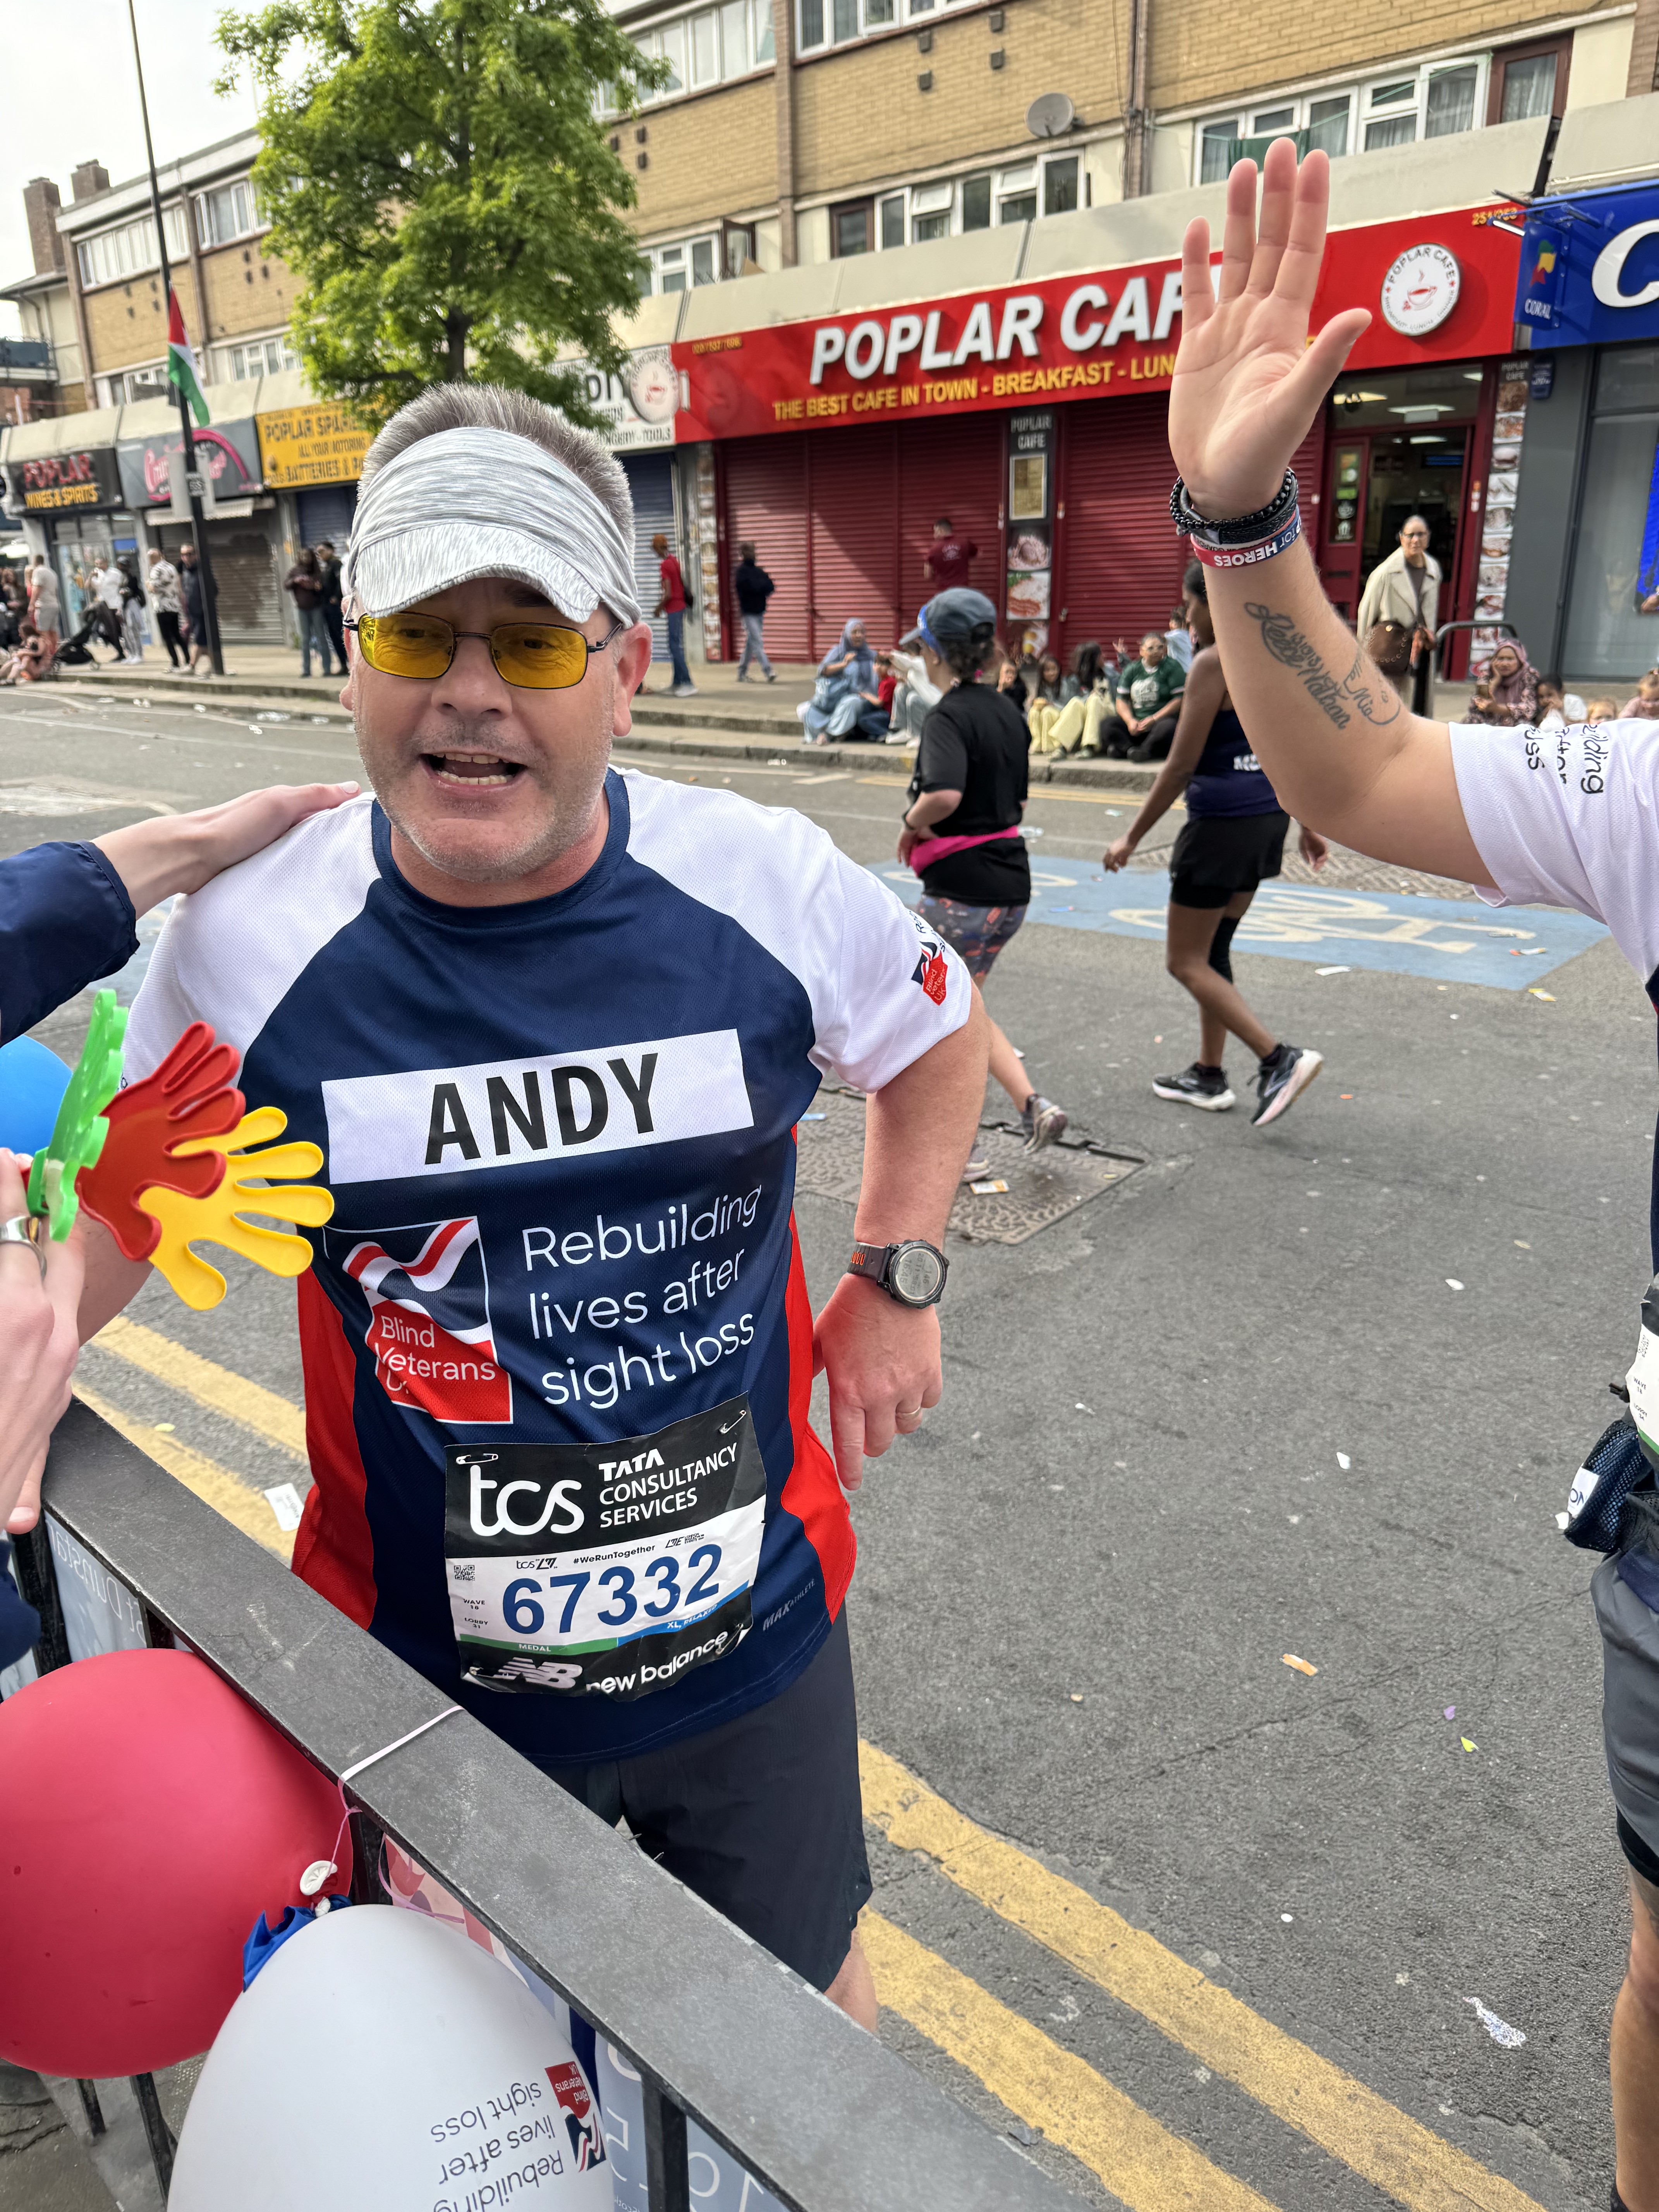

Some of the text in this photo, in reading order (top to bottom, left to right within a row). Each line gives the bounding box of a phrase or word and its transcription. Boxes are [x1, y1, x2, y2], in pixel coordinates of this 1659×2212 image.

[1388, 247, 1455, 283] POPLAR CAFE
[809, 294, 1044, 386] POPLAR
[775, 400, 804, 421] THE
[807, 393, 850, 417] BEST
[852, 385, 898, 412] CAFE
[901, 383, 919, 406] IN
[923, 378, 978, 404] TOWN
[993, 360, 1115, 397] BREAKFAST
[264, 419, 313, 444] POPLAR
[1010, 415, 1052, 433] POPLAR
[1017, 433, 1046, 450] CAFE
[23, 453, 93, 489] POPLAR
[24, 489, 55, 508] WINES
[61, 484, 98, 505] SPIRITS
[1214, 527, 1297, 567] for HEROES
[1297, 670, 1351, 730] Nathan
[425, 1053, 658, 1165] ANDY
[522, 1184, 762, 1272] Rebuilding
[529, 1249, 745, 1340] lives after
[381, 1315, 435, 1348] Blind
[374, 1342, 496, 1381] Veterans
[386, 1369, 409, 1394] U
[542, 1314, 754, 1410] sight loss
[599, 1448, 665, 1482] TATA
[599, 1442, 738, 1506] CONSULTANCY
[470, 1465, 585, 1537] tcs
[599, 1486, 698, 1528] SERVICES
[573, 1544, 656, 1565] #WeRunTogether
[502, 1544, 723, 1634] 67332
[763, 1578, 815, 1632] MAX ATHLETE
[683, 1604, 718, 1625] RELAXED
[519, 1643, 551, 1652] MEDAL
[586, 1631, 729, 1694] new balance
[555, 2076, 584, 2093] Veterans
[573, 2089, 589, 2105] Blind
[430, 2083, 541, 2143] sight loss
[438, 2114, 556, 2185] lives after
